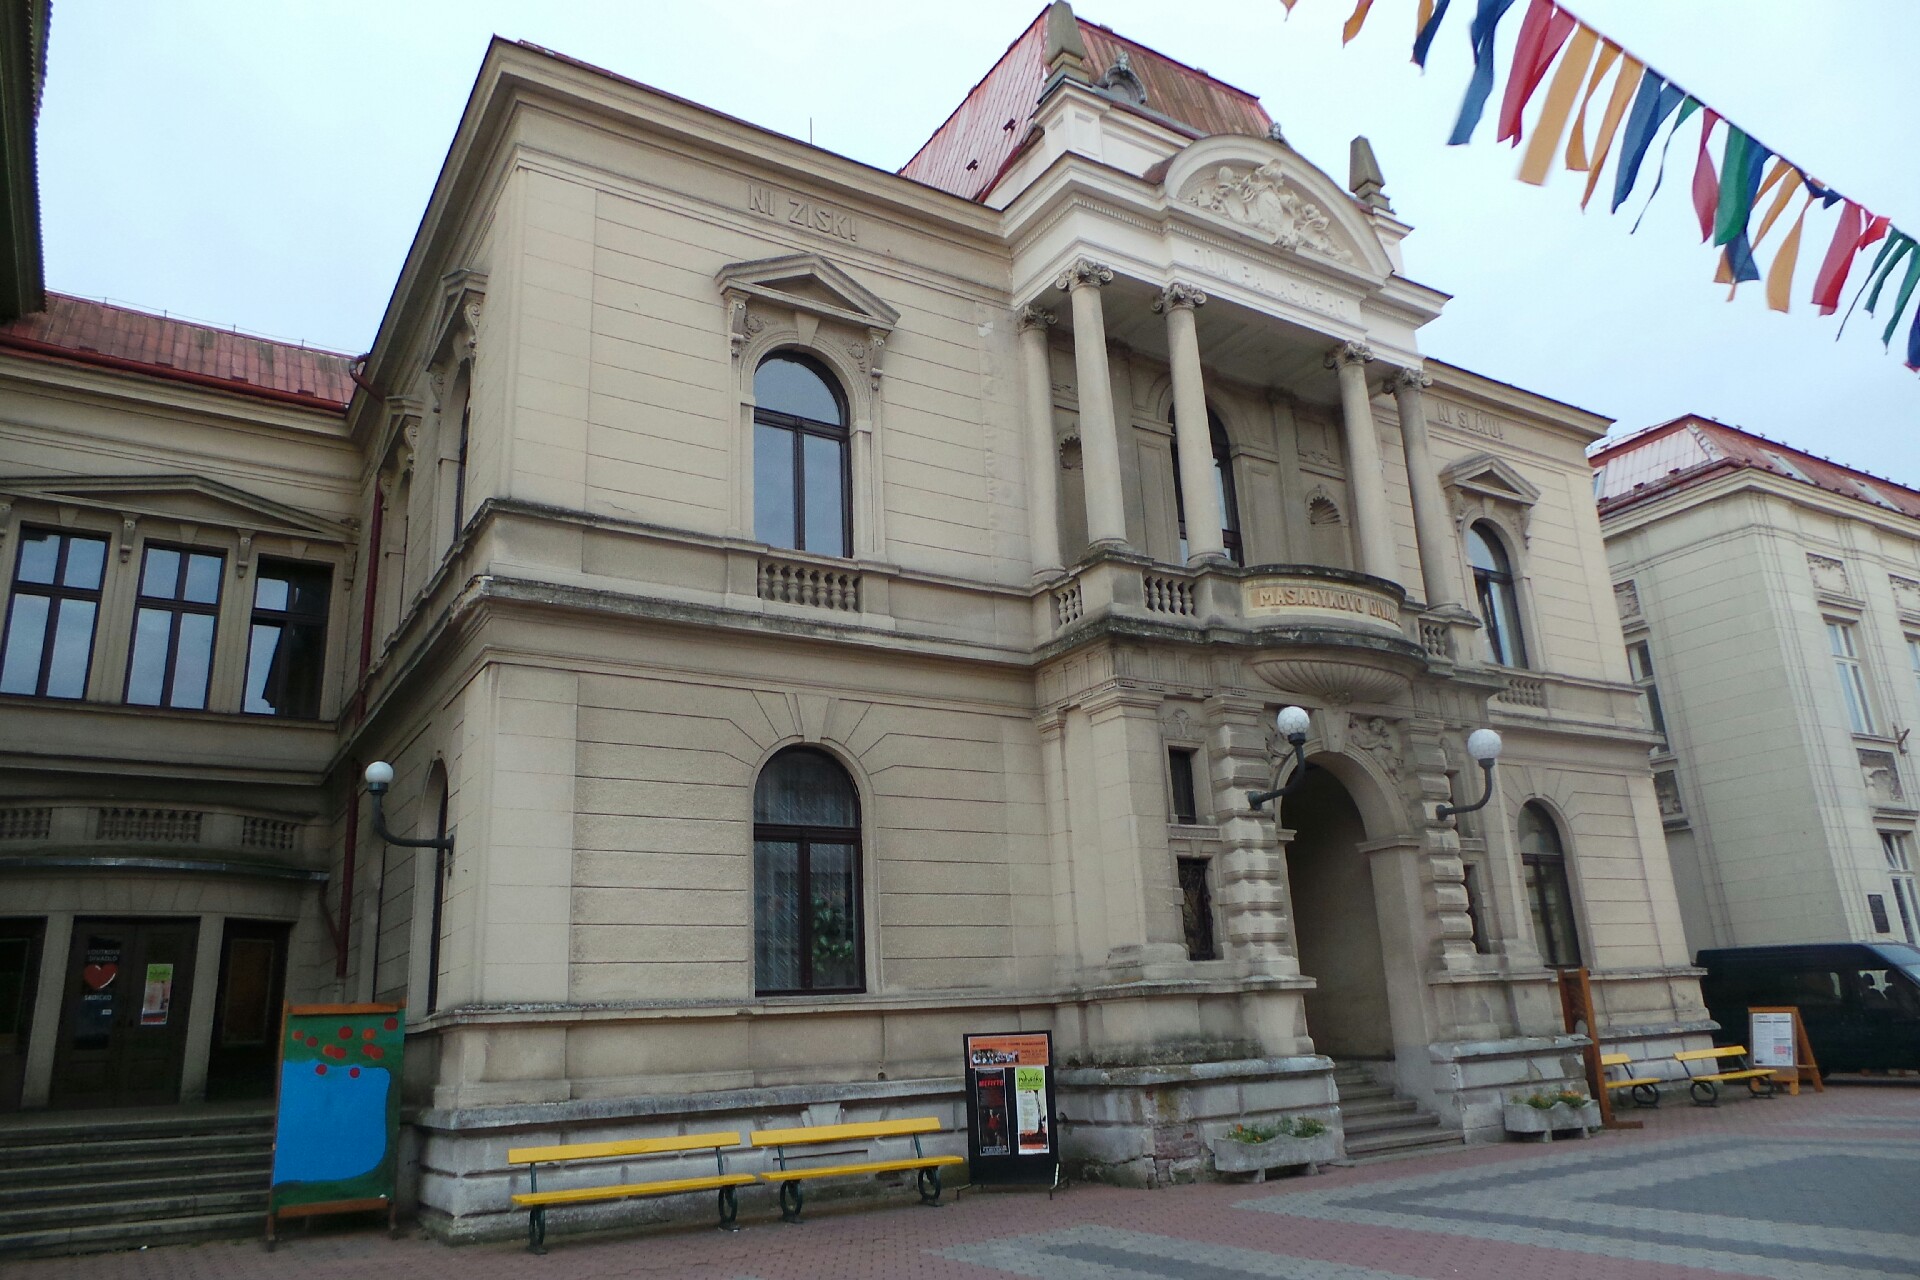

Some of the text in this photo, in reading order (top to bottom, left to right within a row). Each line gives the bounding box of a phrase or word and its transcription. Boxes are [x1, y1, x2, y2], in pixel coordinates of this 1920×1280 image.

[749, 184, 857, 242] NI ZISK!
[1437, 402, 1453, 425] NI
[1259, 587, 1364, 613] MASARYKOVO
